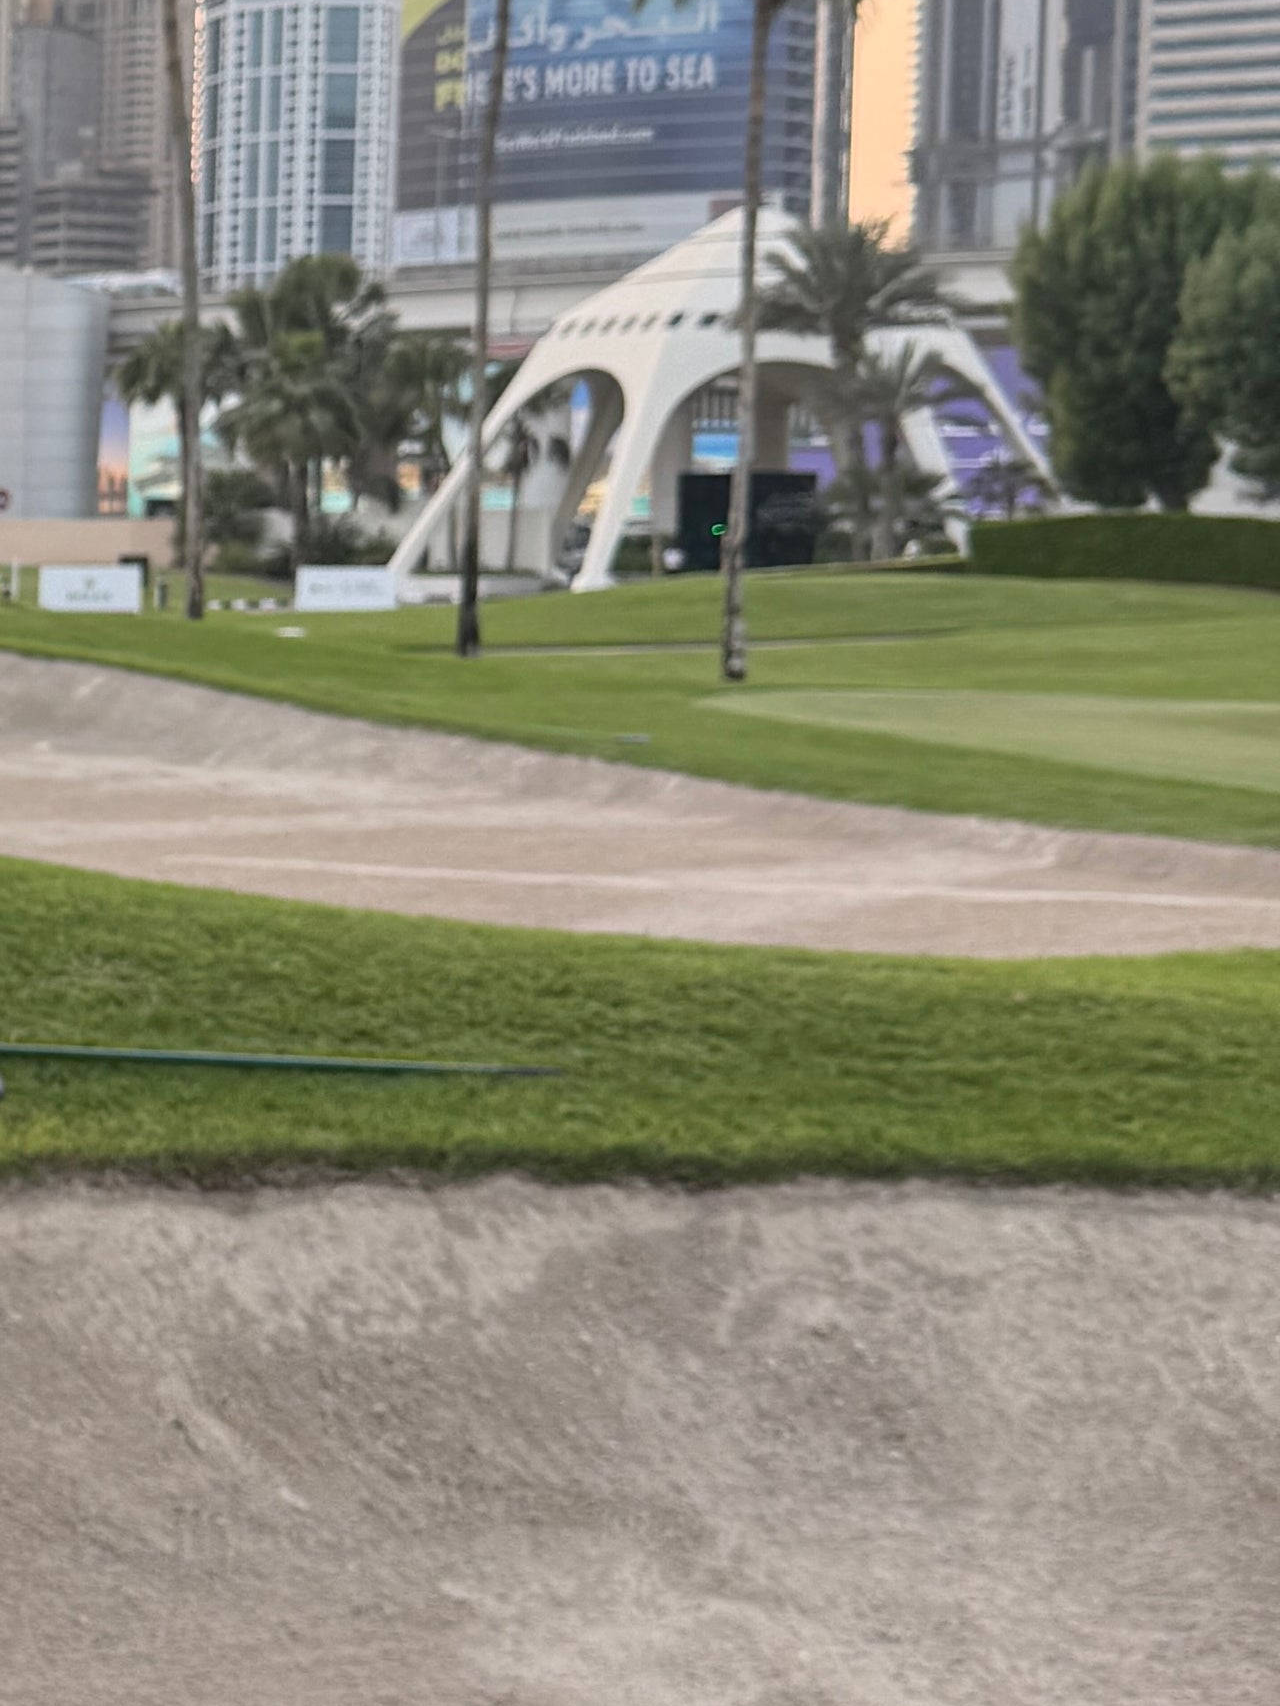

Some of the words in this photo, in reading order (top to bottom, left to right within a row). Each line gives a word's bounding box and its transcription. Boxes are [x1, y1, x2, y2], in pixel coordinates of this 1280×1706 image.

[544, 57, 618, 99] MORE
[625, 54, 659, 93] TO
[664, 53, 716, 90] SEA
